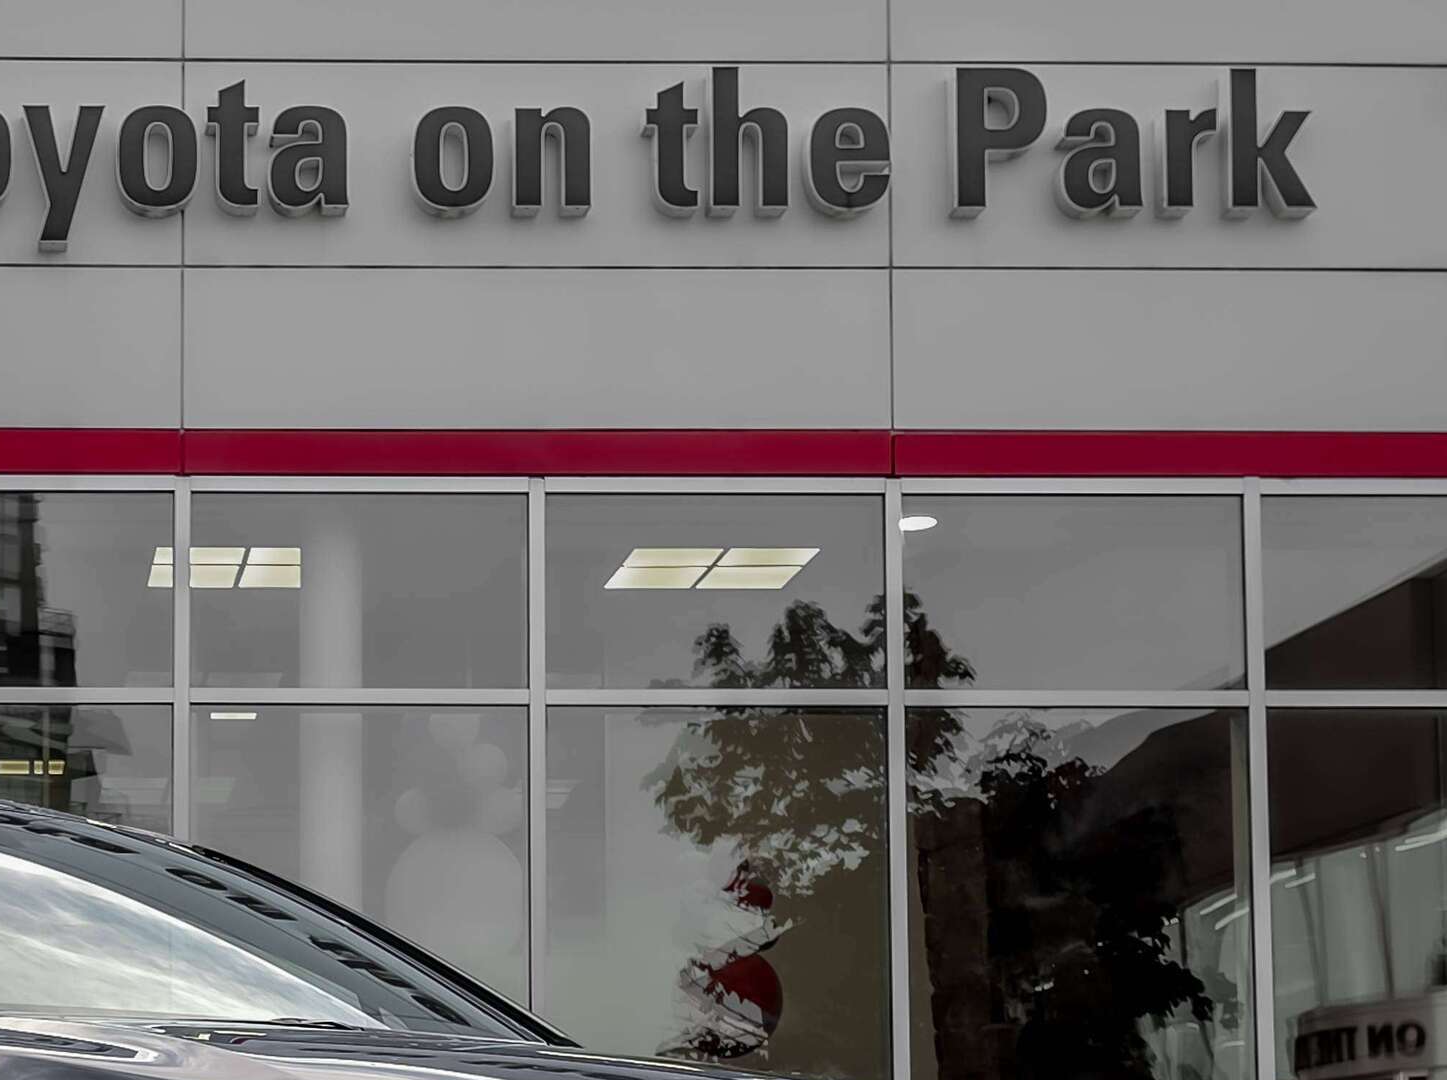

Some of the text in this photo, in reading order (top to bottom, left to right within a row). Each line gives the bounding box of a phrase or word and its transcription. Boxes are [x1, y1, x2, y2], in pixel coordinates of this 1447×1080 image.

[412, 106, 592, 216] on
[641, 67, 891, 216] the
[950, 67, 1318, 217] Park
